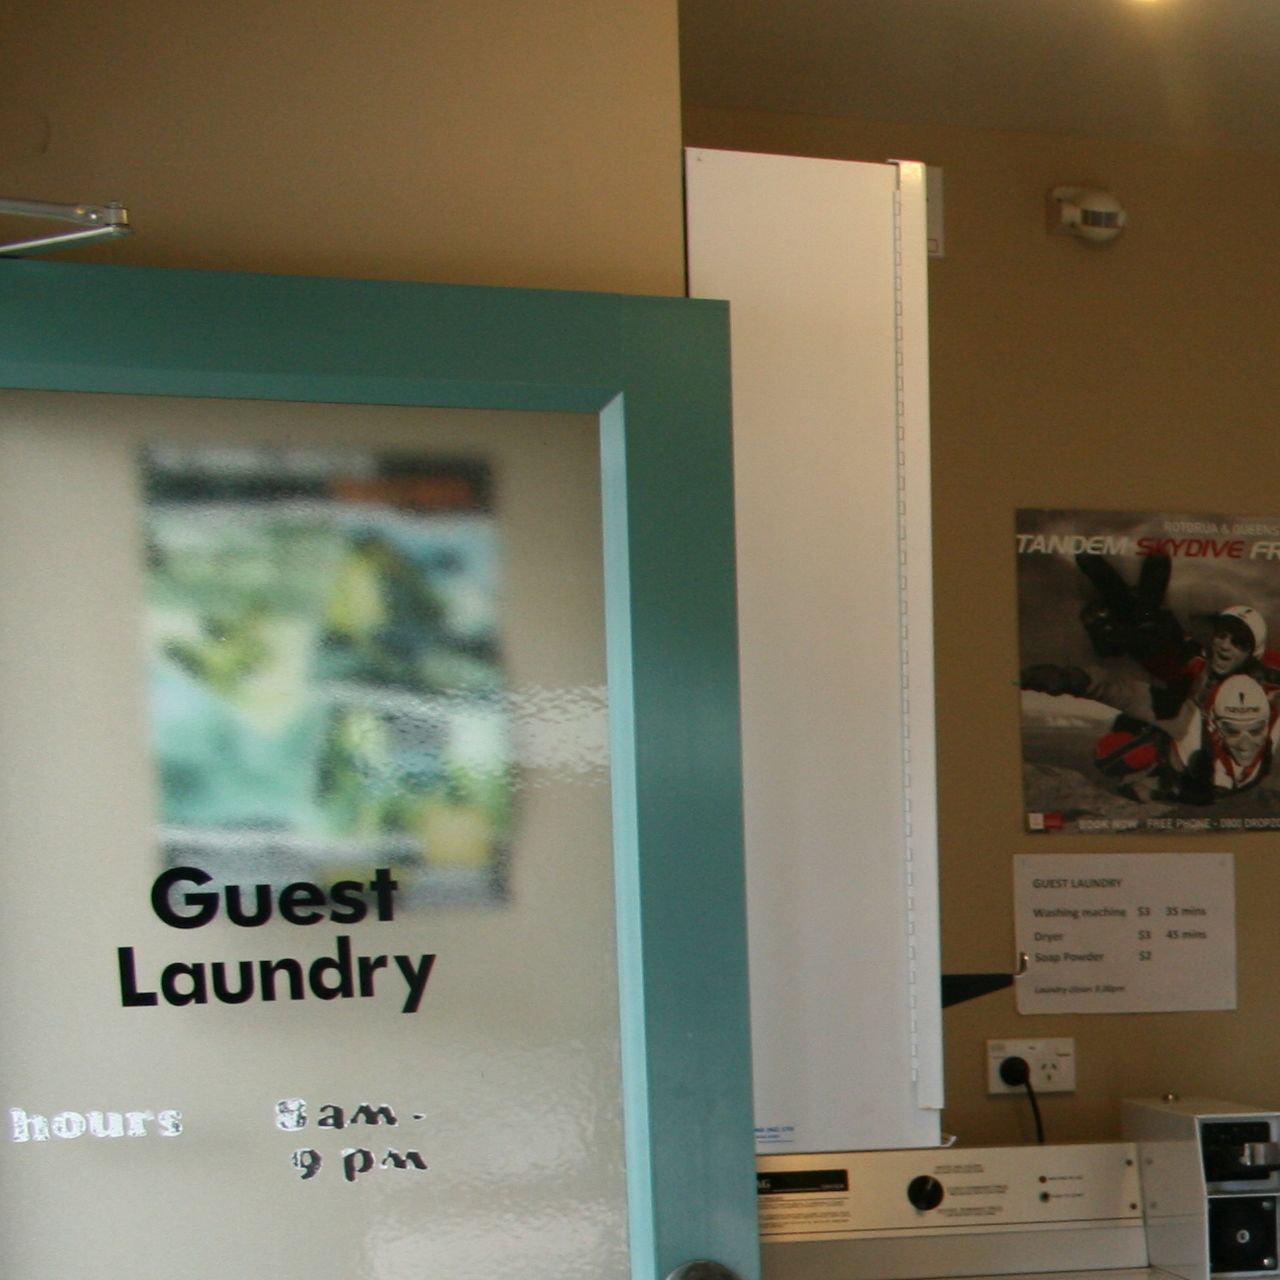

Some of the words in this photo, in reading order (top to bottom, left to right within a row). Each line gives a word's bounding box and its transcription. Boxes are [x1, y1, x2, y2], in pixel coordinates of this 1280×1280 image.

[1016, 533, 1131, 556] TANDEM
[1135, 537, 1246, 560] SKYDIVE
[150, 866, 400, 930] Guest
[1032, 878, 1068, 889] GUEST
[1070, 878, 1123, 889] LAUNDRY
[116, 935, 437, 1014] Laundry
[9, 1106, 185, 1144] hours
